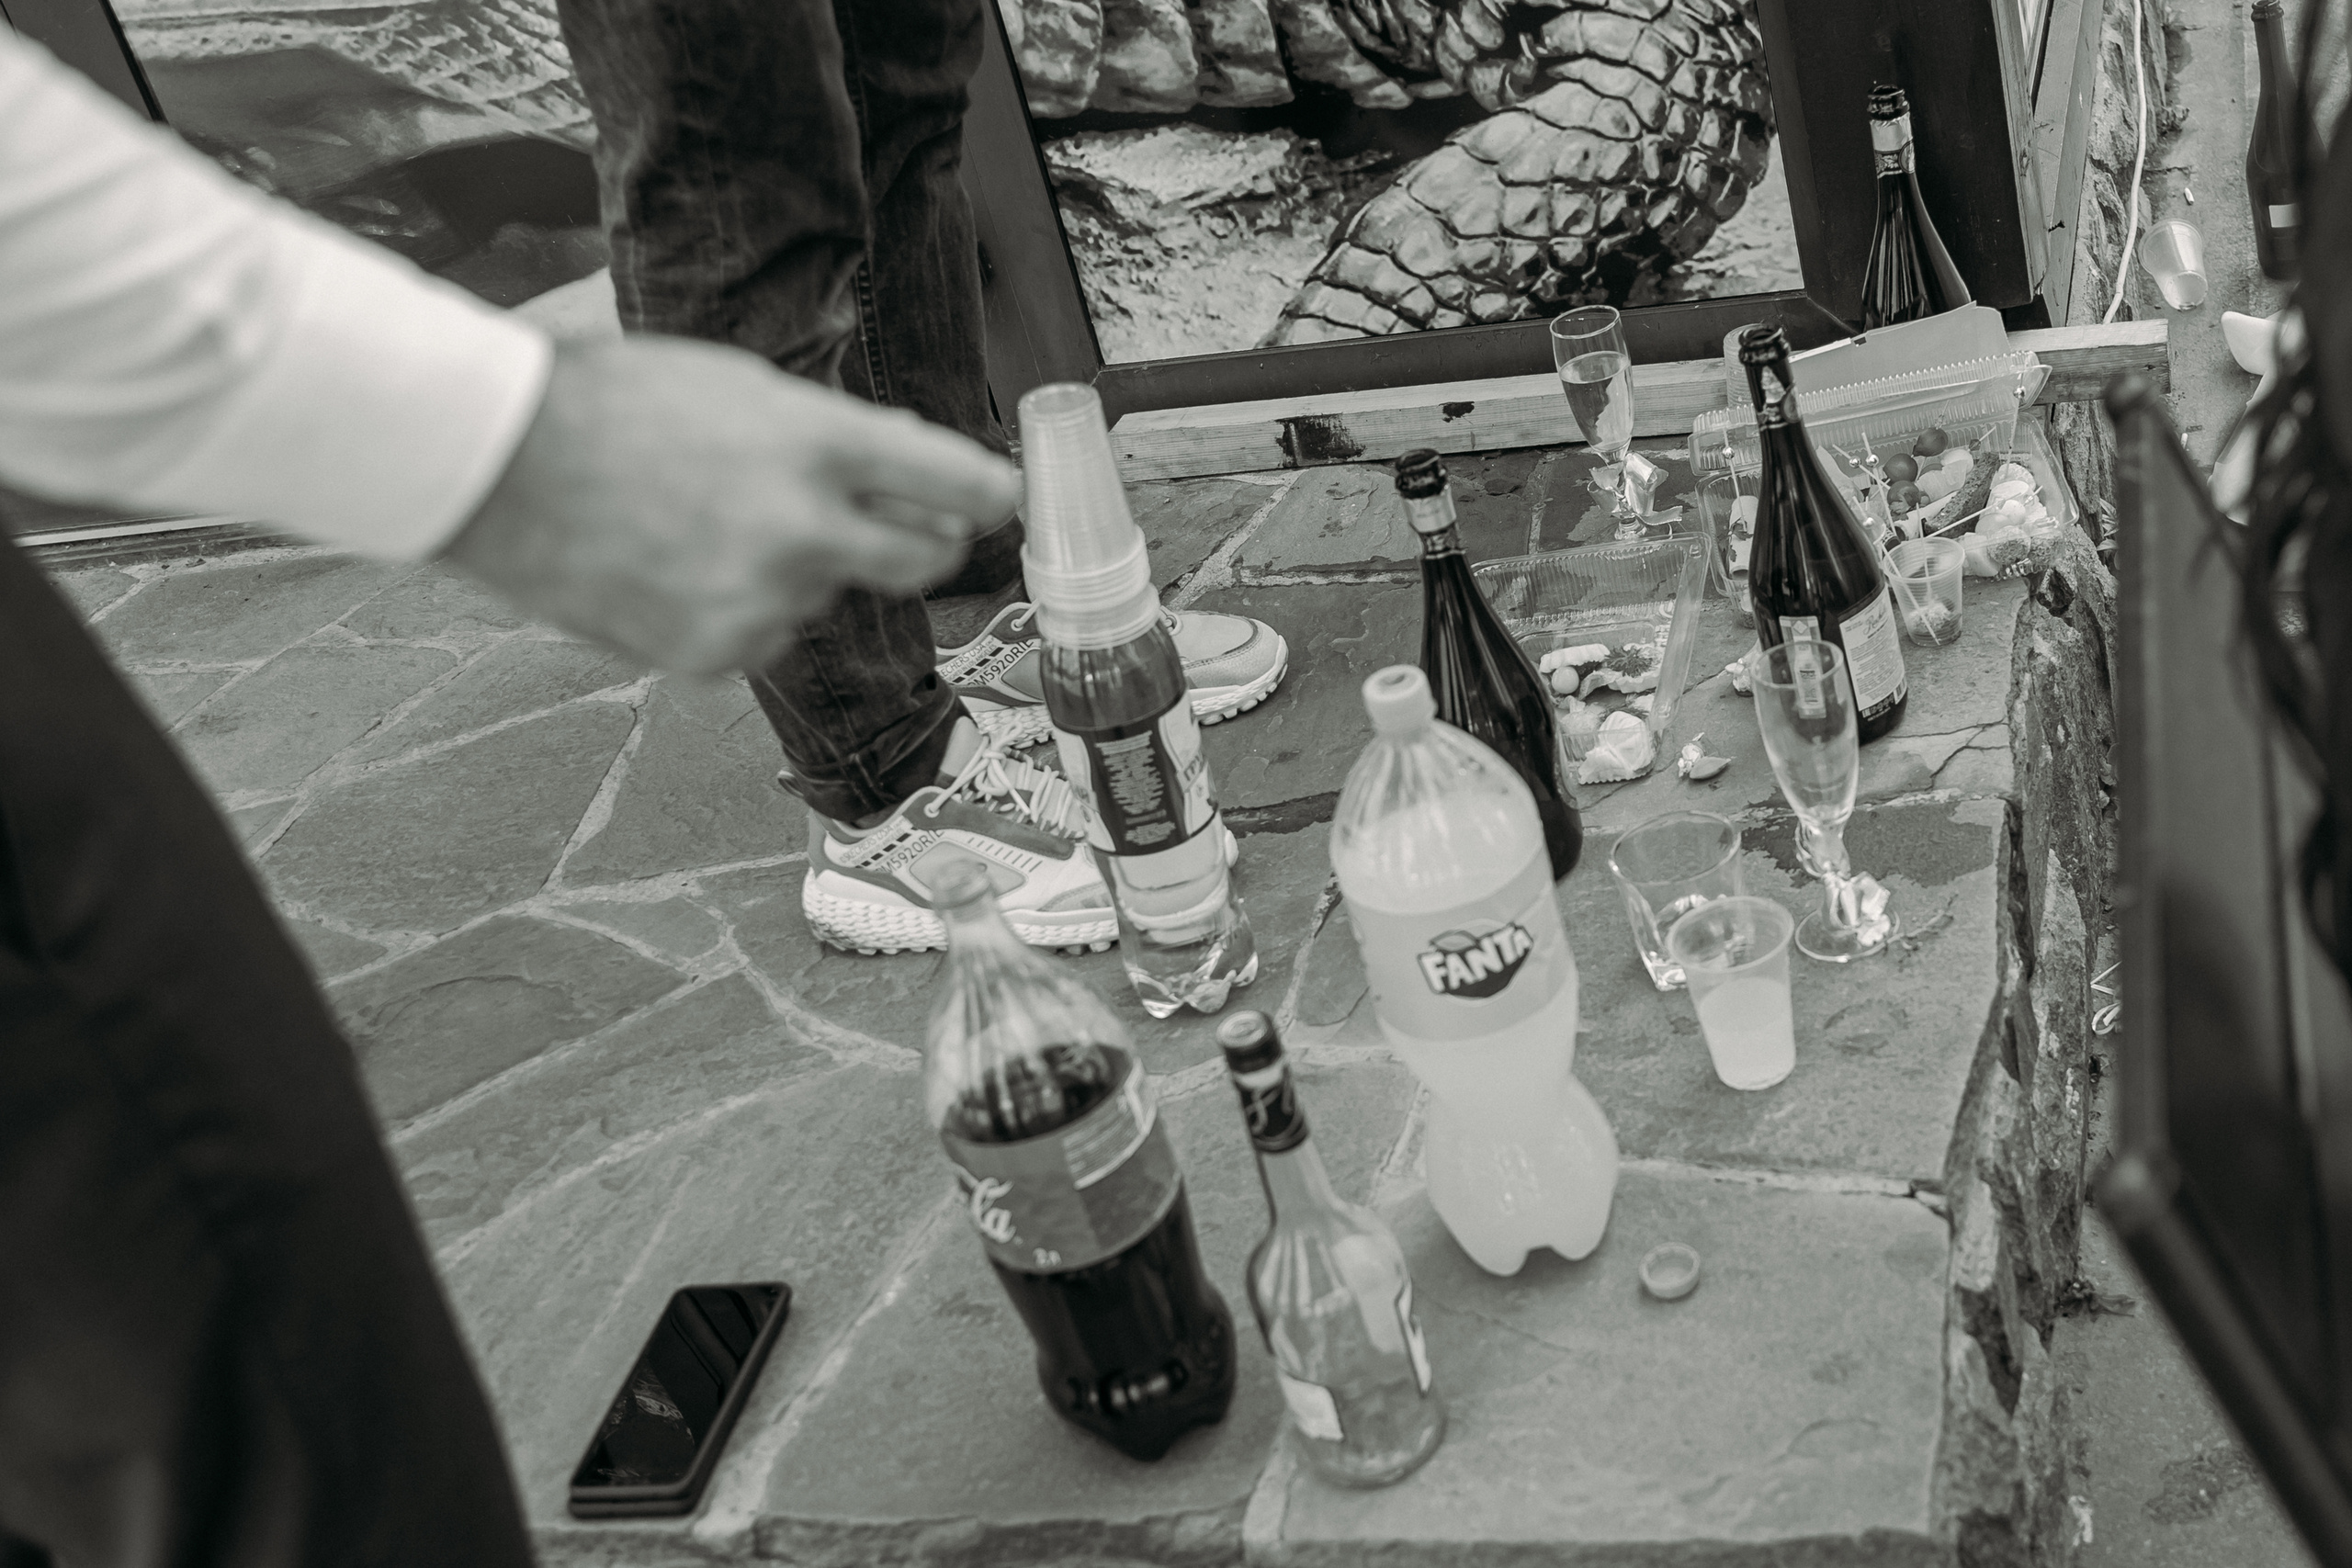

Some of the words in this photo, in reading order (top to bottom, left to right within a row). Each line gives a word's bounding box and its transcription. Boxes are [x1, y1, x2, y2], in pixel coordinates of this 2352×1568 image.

[939, 651, 970, 678] ECHERS
[969, 641, 987, 658] USA
[875, 829, 945, 874] M5920RIE
[1419, 924, 1532, 992] FANTA
